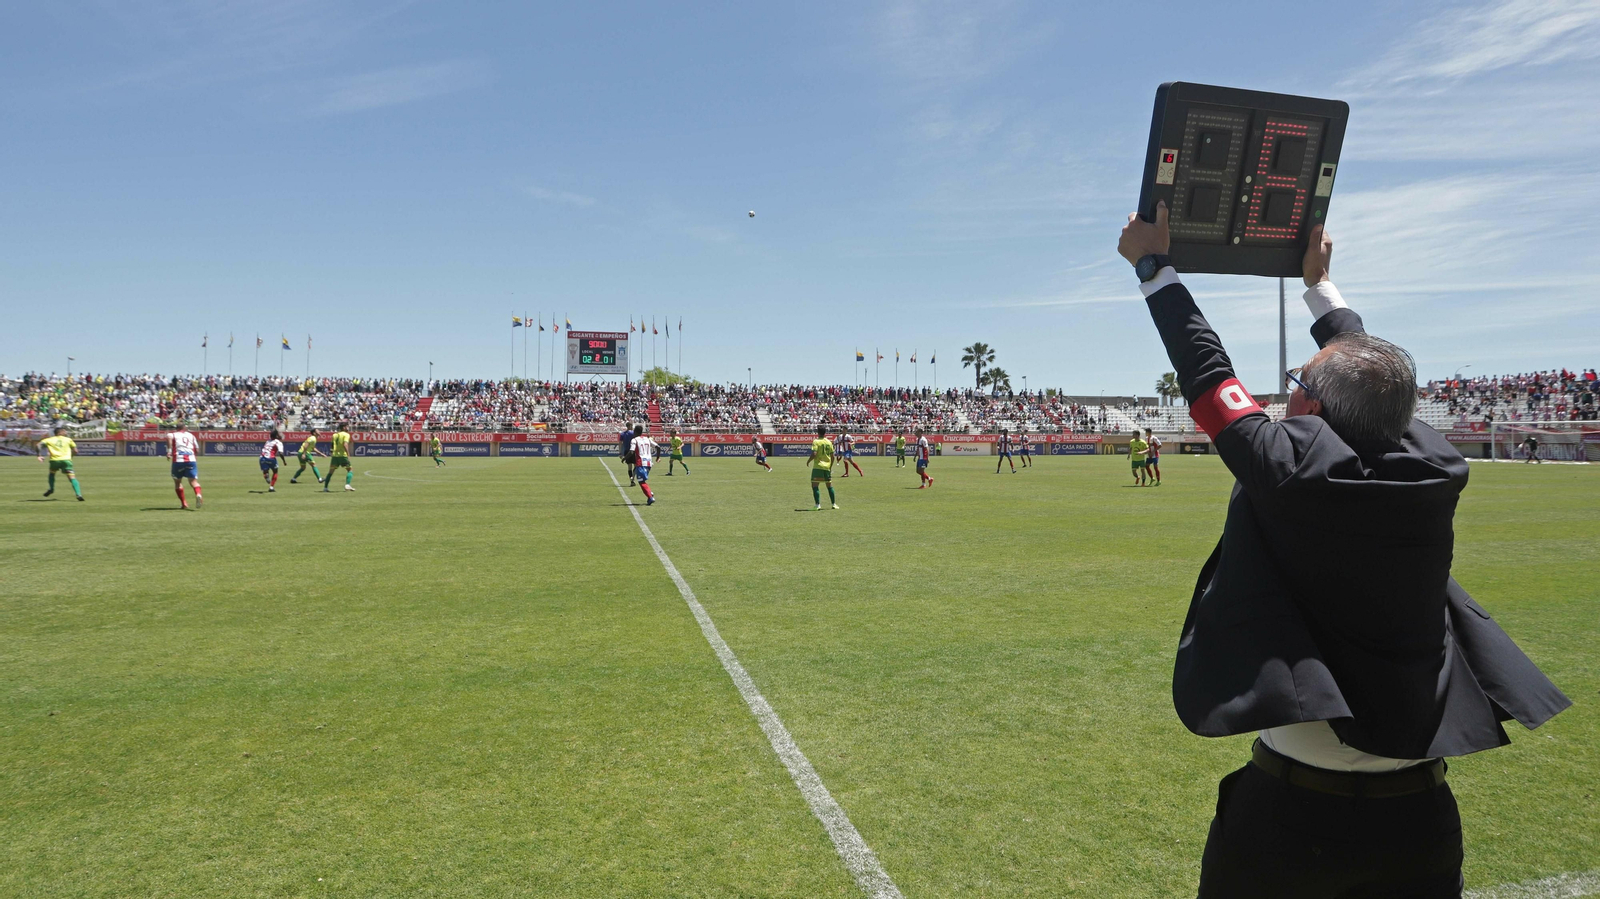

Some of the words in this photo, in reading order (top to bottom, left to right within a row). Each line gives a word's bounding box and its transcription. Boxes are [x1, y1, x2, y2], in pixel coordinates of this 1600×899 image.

[1166, 153, 1173, 163] 6
[1245, 121, 1308, 239] 6
[582, 355, 592, 363] 02
[198, 432, 244, 440] Mercure
[363, 432, 410, 441] PADILLA
[459, 433, 494, 442] ESTRECHO
[182, 436, 189, 447] 9
